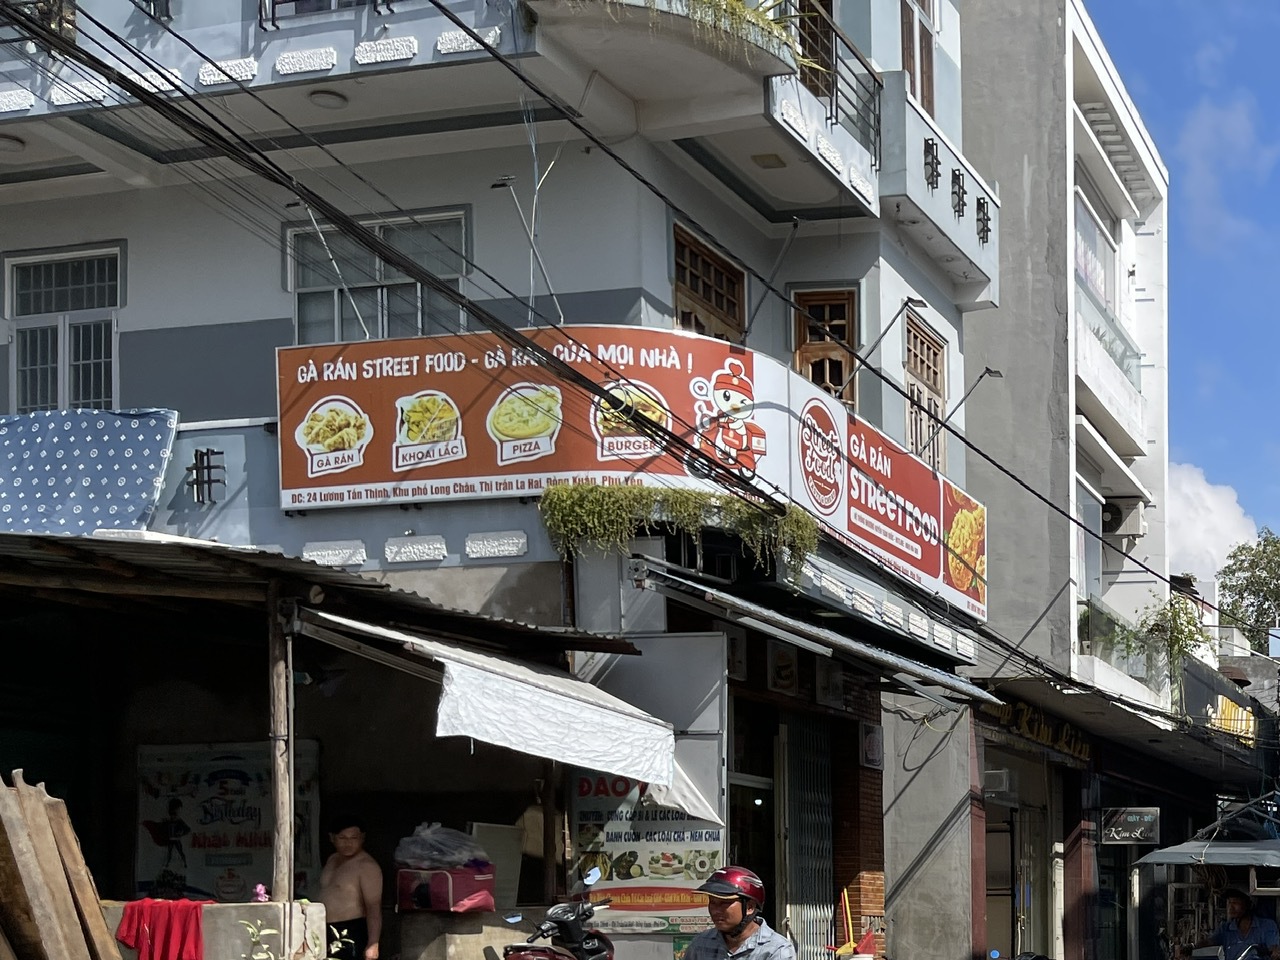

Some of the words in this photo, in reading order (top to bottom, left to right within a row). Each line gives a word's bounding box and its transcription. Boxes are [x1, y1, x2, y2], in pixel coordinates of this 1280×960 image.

[297, 359, 318, 383] GÀ
[323, 356, 357, 381] RÁN
[362, 355, 419, 379] STREET
[425, 352, 466, 373] FOOD
[484, 344, 506, 369] GÀ
[553, 339, 591, 364] CỦA
[597, 344, 634, 370] MỌI
[640, 345, 681, 370] NHÀ
[401, 448, 435, 463] KHOAI
[512, 441, 541, 454] PIZZA
[607, 440, 656, 452] BURGER
[850, 433, 867, 465] GÀ
[869, 446, 892, 479] RÁN
[317, 456, 331, 468] GÀ
[334, 453, 354, 466] RÁN
[307, 492, 317, 503] 24
[319, 490, 345, 504] Lương
[392, 486, 409, 498] Khu
[430, 483, 450, 498] Long
[479, 480, 493, 494] Thị
[515, 479, 525, 491] La
[906, 502, 939, 547] FOOD
